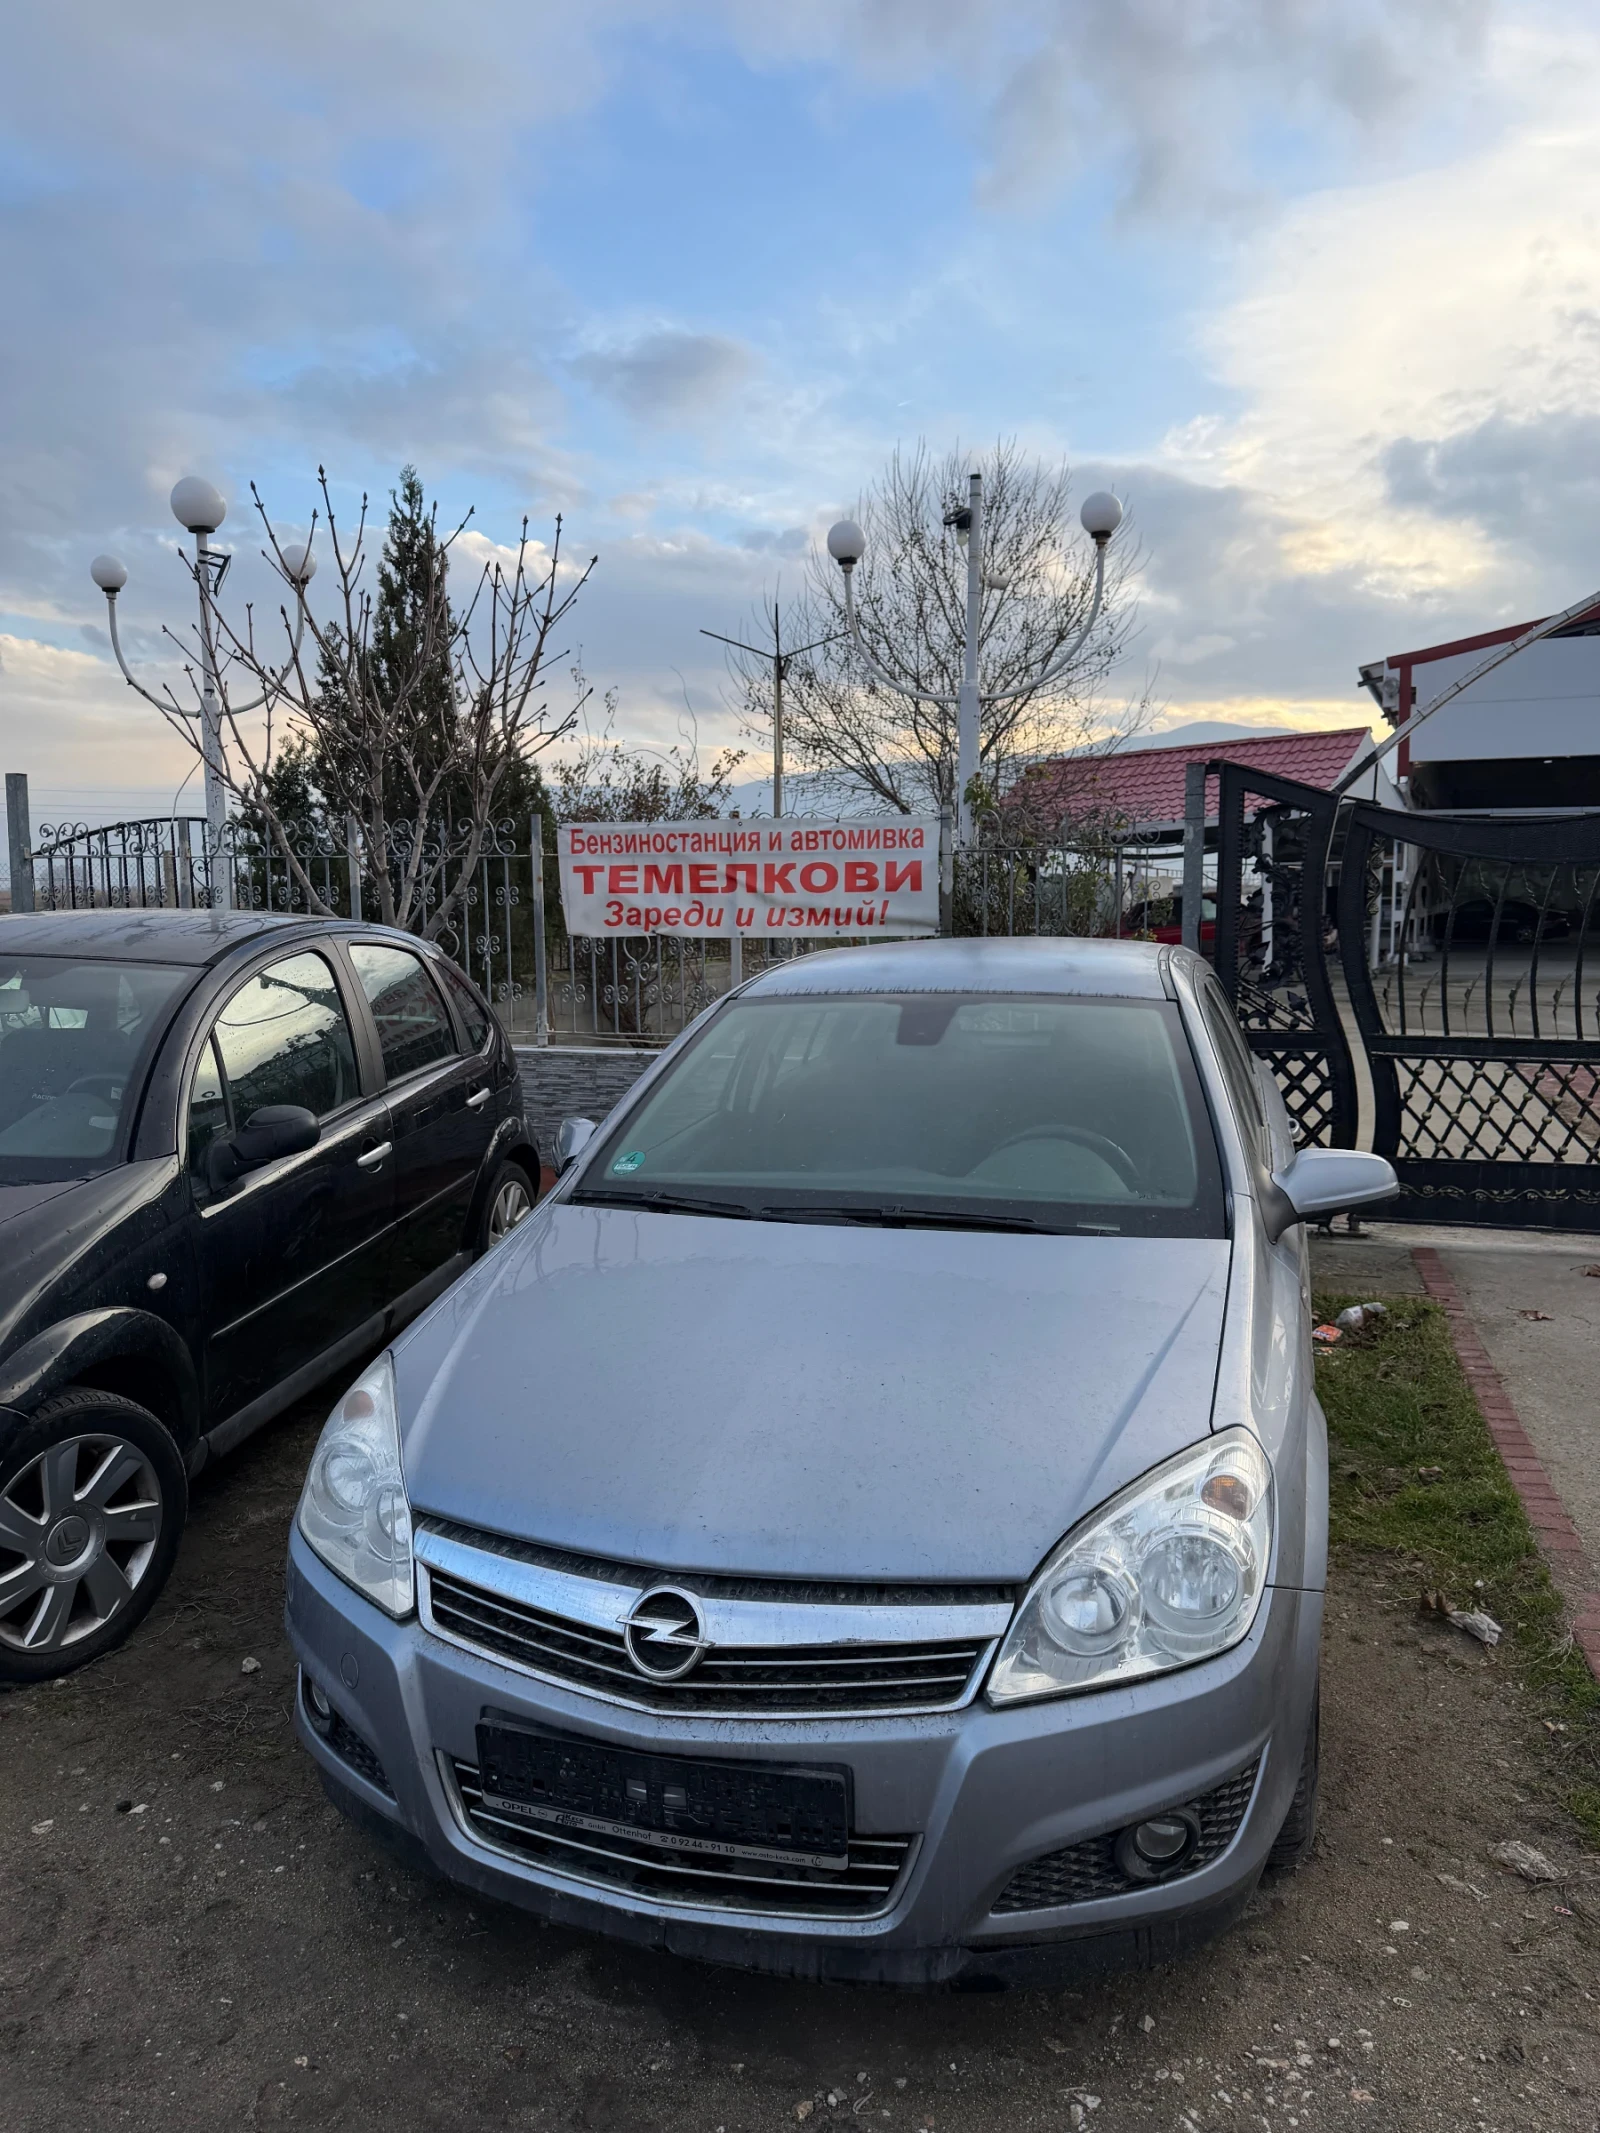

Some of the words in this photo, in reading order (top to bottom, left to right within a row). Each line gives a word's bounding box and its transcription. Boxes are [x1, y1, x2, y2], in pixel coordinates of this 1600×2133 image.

[570, 828, 760, 856] Бензиностанция
[768, 834, 782, 851] и
[790, 828, 924, 851] автомивка
[573, 860, 923, 895] ТЕМЕЛКОВИ
[603, 900, 723, 931] Зареди
[734, 907, 753, 927] и
[766, 899, 890, 927] измий!
[626, 1152, 639, 1163] 4
[501, 1801, 536, 1815] OPEL
[612, 1826, 652, 1840] Ottenhof
